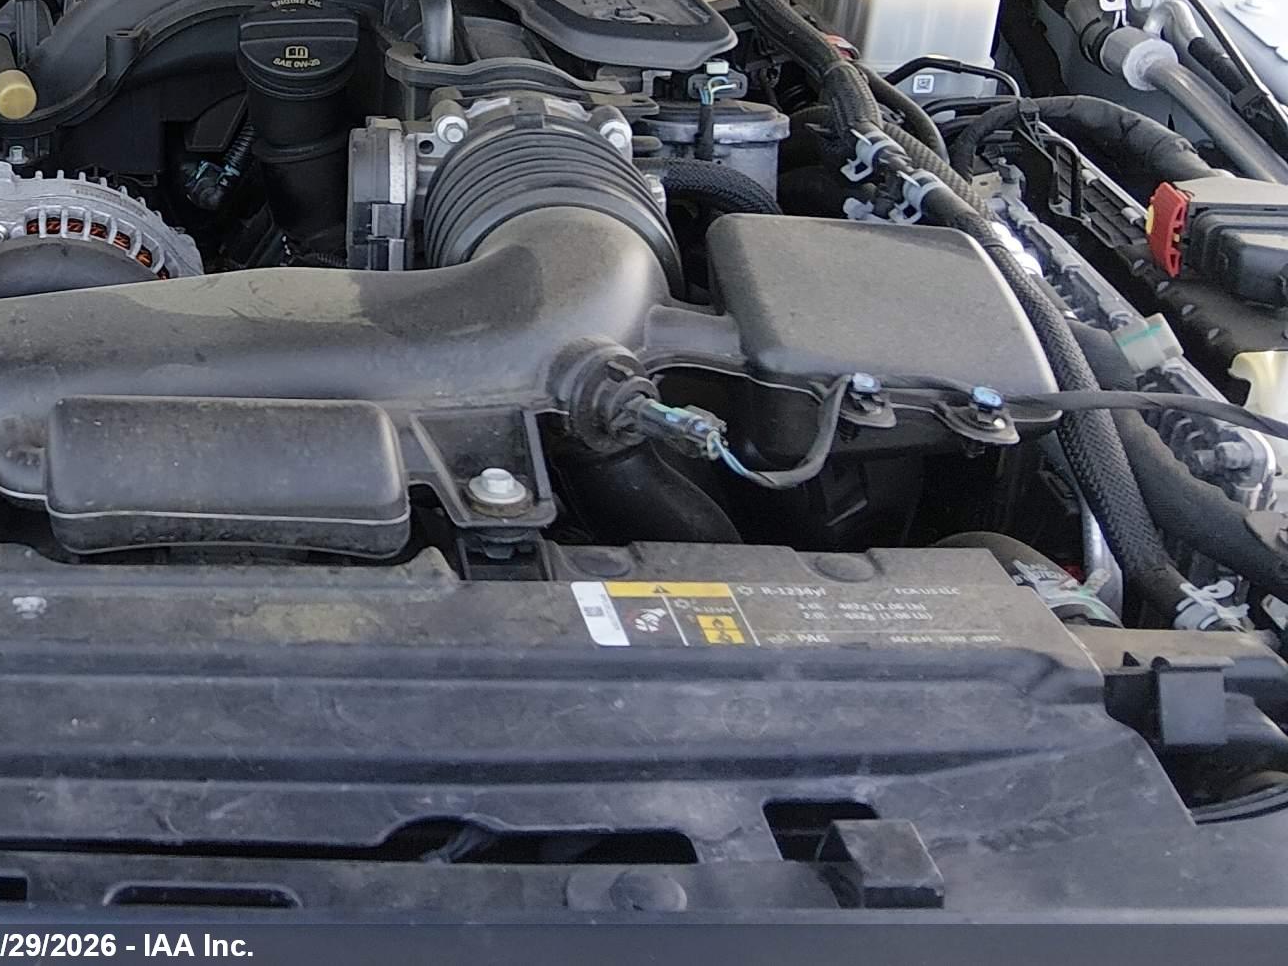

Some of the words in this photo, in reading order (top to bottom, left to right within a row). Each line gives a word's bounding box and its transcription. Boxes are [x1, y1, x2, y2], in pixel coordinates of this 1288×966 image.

[307, 0, 322, 9] OIL
[273, 58, 292, 68] SAE
[761, 586, 827, 597] R-1234yf
[797, 634, 831, 643] PAG
